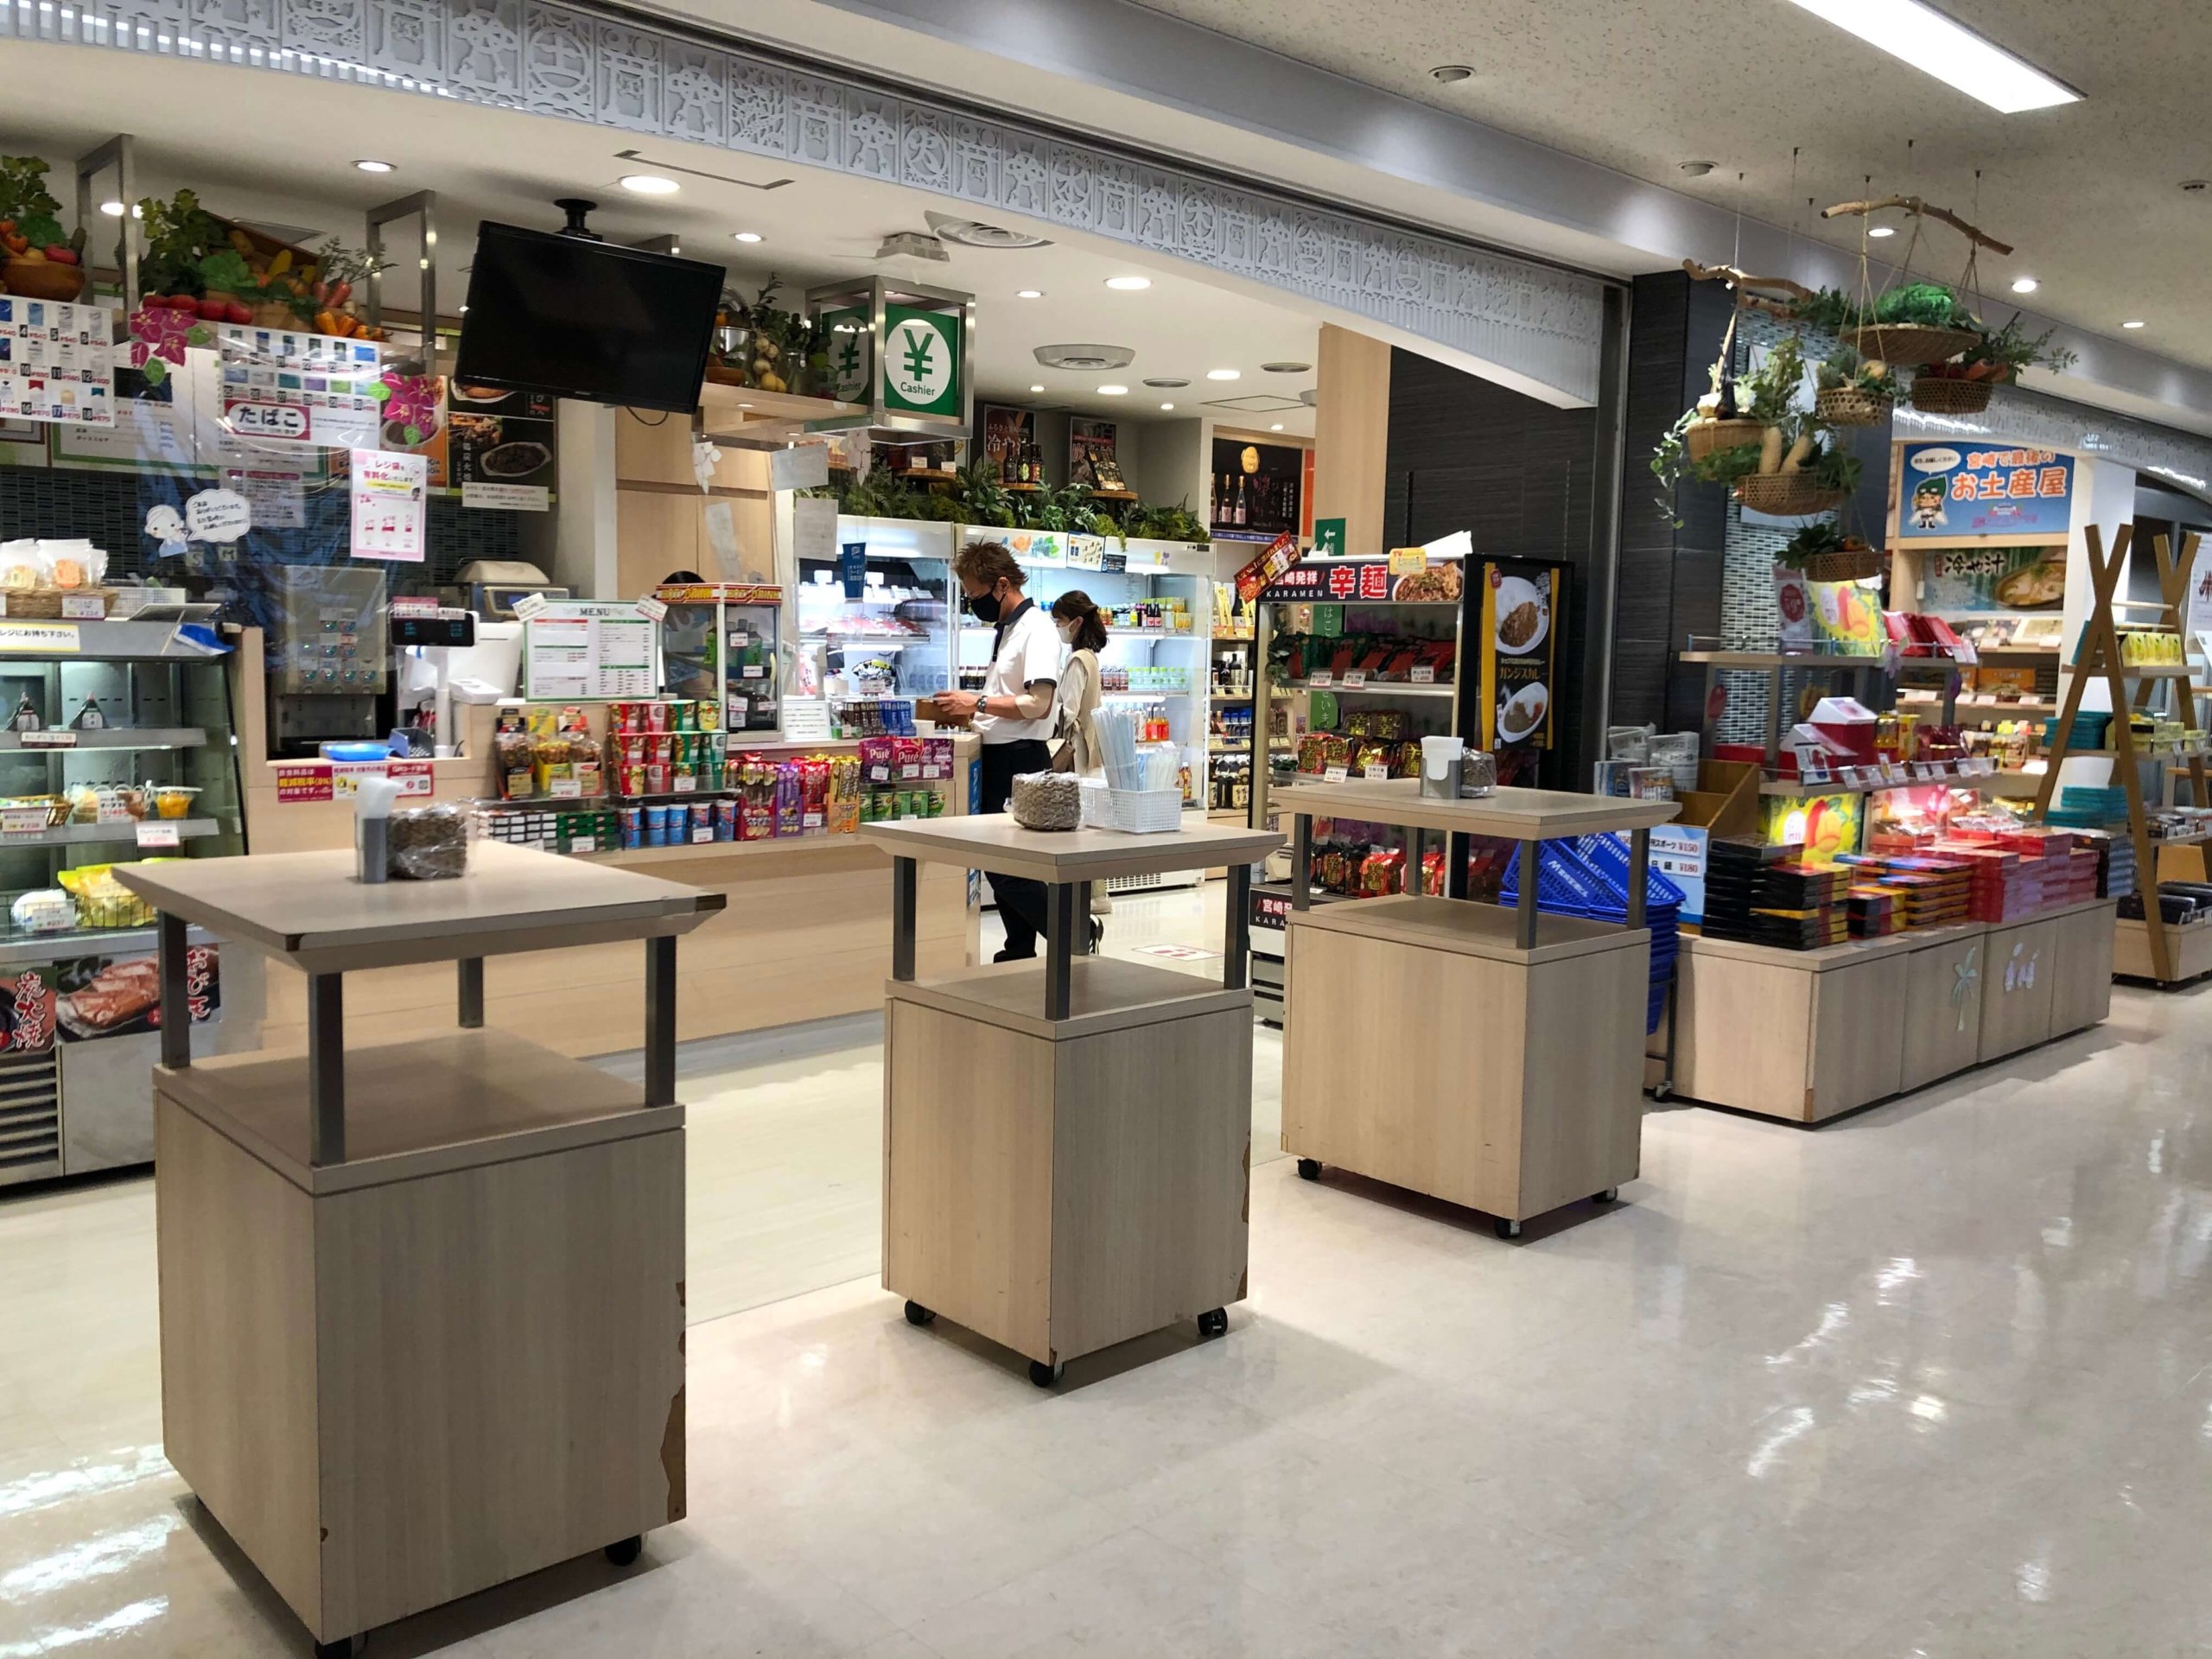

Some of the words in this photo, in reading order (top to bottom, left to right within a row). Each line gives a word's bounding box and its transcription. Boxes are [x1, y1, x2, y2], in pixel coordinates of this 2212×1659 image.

[20, 325, 28, 338] 4
[51, 328, 58, 341] 5
[52, 366, 61, 379] 11
[82, 370, 92, 383] 12
[900, 381, 936, 397] Cashier
[52, 405, 62, 417] 17
[239, 406, 298, 427] たばこ
[1967, 449, 2056, 469] 宮崎で最後の
[1951, 467, 2066, 501] お土産屋
[1944, 553, 2004, 575] 冷や汁
[1330, 564, 1388, 600] 辛麺
[1267, 589, 1323, 598] KARAMEN
[580, 607, 610, 616] MENU
[1678, 842, 1698, 853] ¥150
[1680, 862, 1698, 873] ¥180
